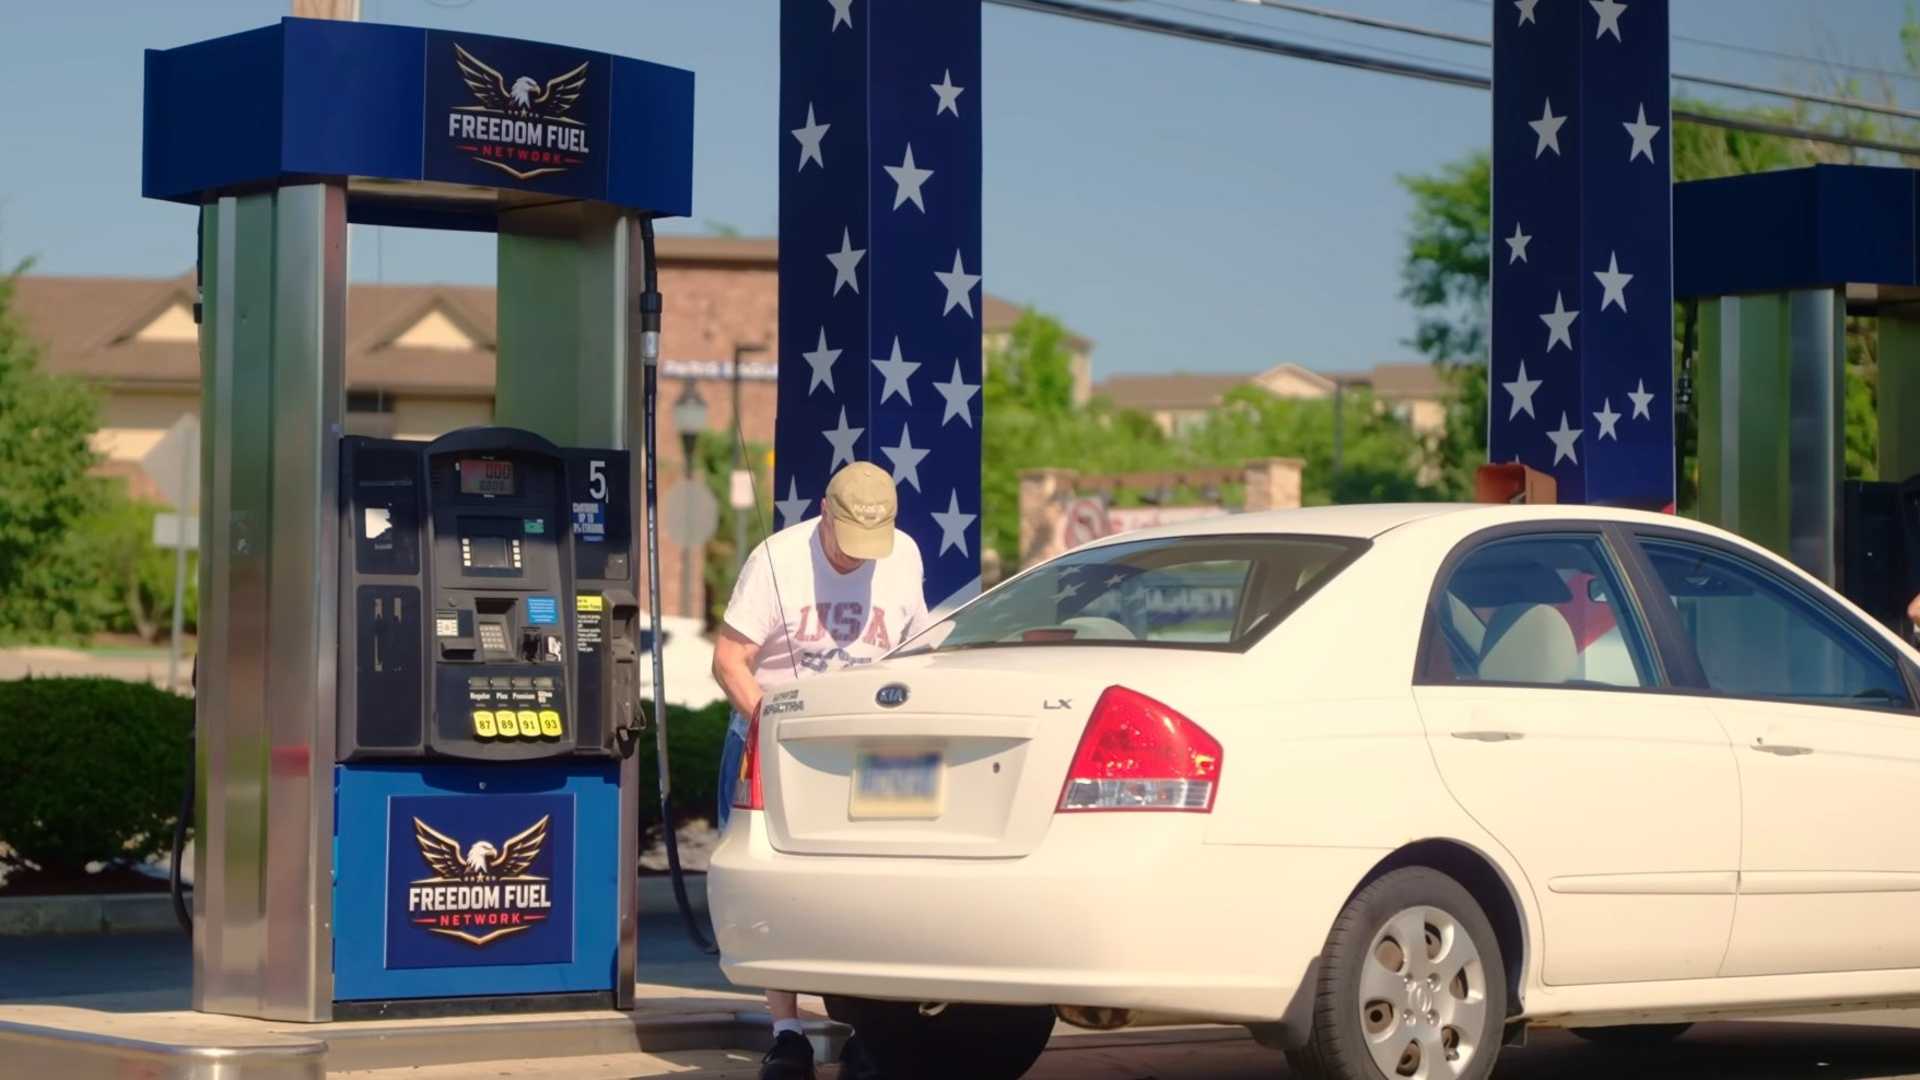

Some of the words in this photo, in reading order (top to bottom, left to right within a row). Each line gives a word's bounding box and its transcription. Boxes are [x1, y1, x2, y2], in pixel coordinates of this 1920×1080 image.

[449, 113, 542, 147] FREEDOM
[547, 125, 590, 153] FUEL
[482, 146, 562, 165] NETWORK
[589, 460, 607, 500] 5
[794, 602, 891, 650] USA
[470, 692, 490, 701] Regular
[496, 692, 508, 700] Plus
[512, 692, 536, 700] Premium
[879, 687, 903, 703] KIA
[1043, 698, 1072, 710] LX
[479, 720, 491, 730] 87
[501, 720, 514, 729] 89
[523, 720, 535, 729] 91
[544, 719, 557, 729] 93
[409, 886, 500, 911] FREEDOM
[504, 884, 551, 908] FUEL
[440, 913, 521, 926] NETWORK
